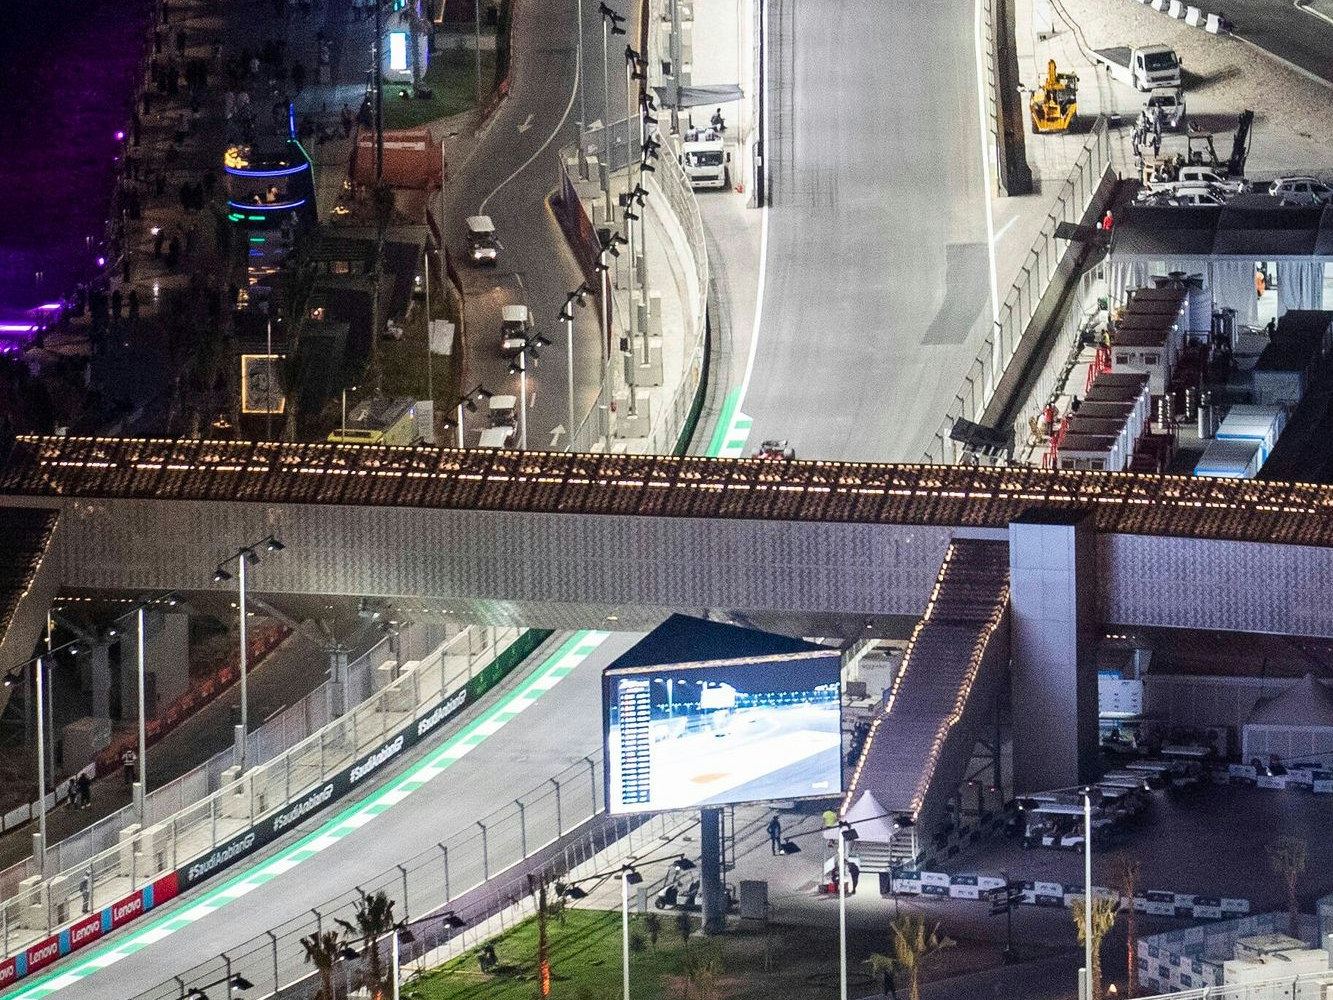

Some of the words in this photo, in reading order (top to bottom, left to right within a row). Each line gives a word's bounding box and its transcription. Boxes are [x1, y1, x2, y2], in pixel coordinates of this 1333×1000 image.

[350, 735, 404, 783] #SaudiArabianGP
[273, 783, 334, 831] #SaudiArabianGP
[188, 832, 255, 882] #SaudiArabianGP
[113, 898, 142, 922] Lenovo
[71, 920, 100, 943] Lenovo
[29, 942, 57, 965] Lenovo
